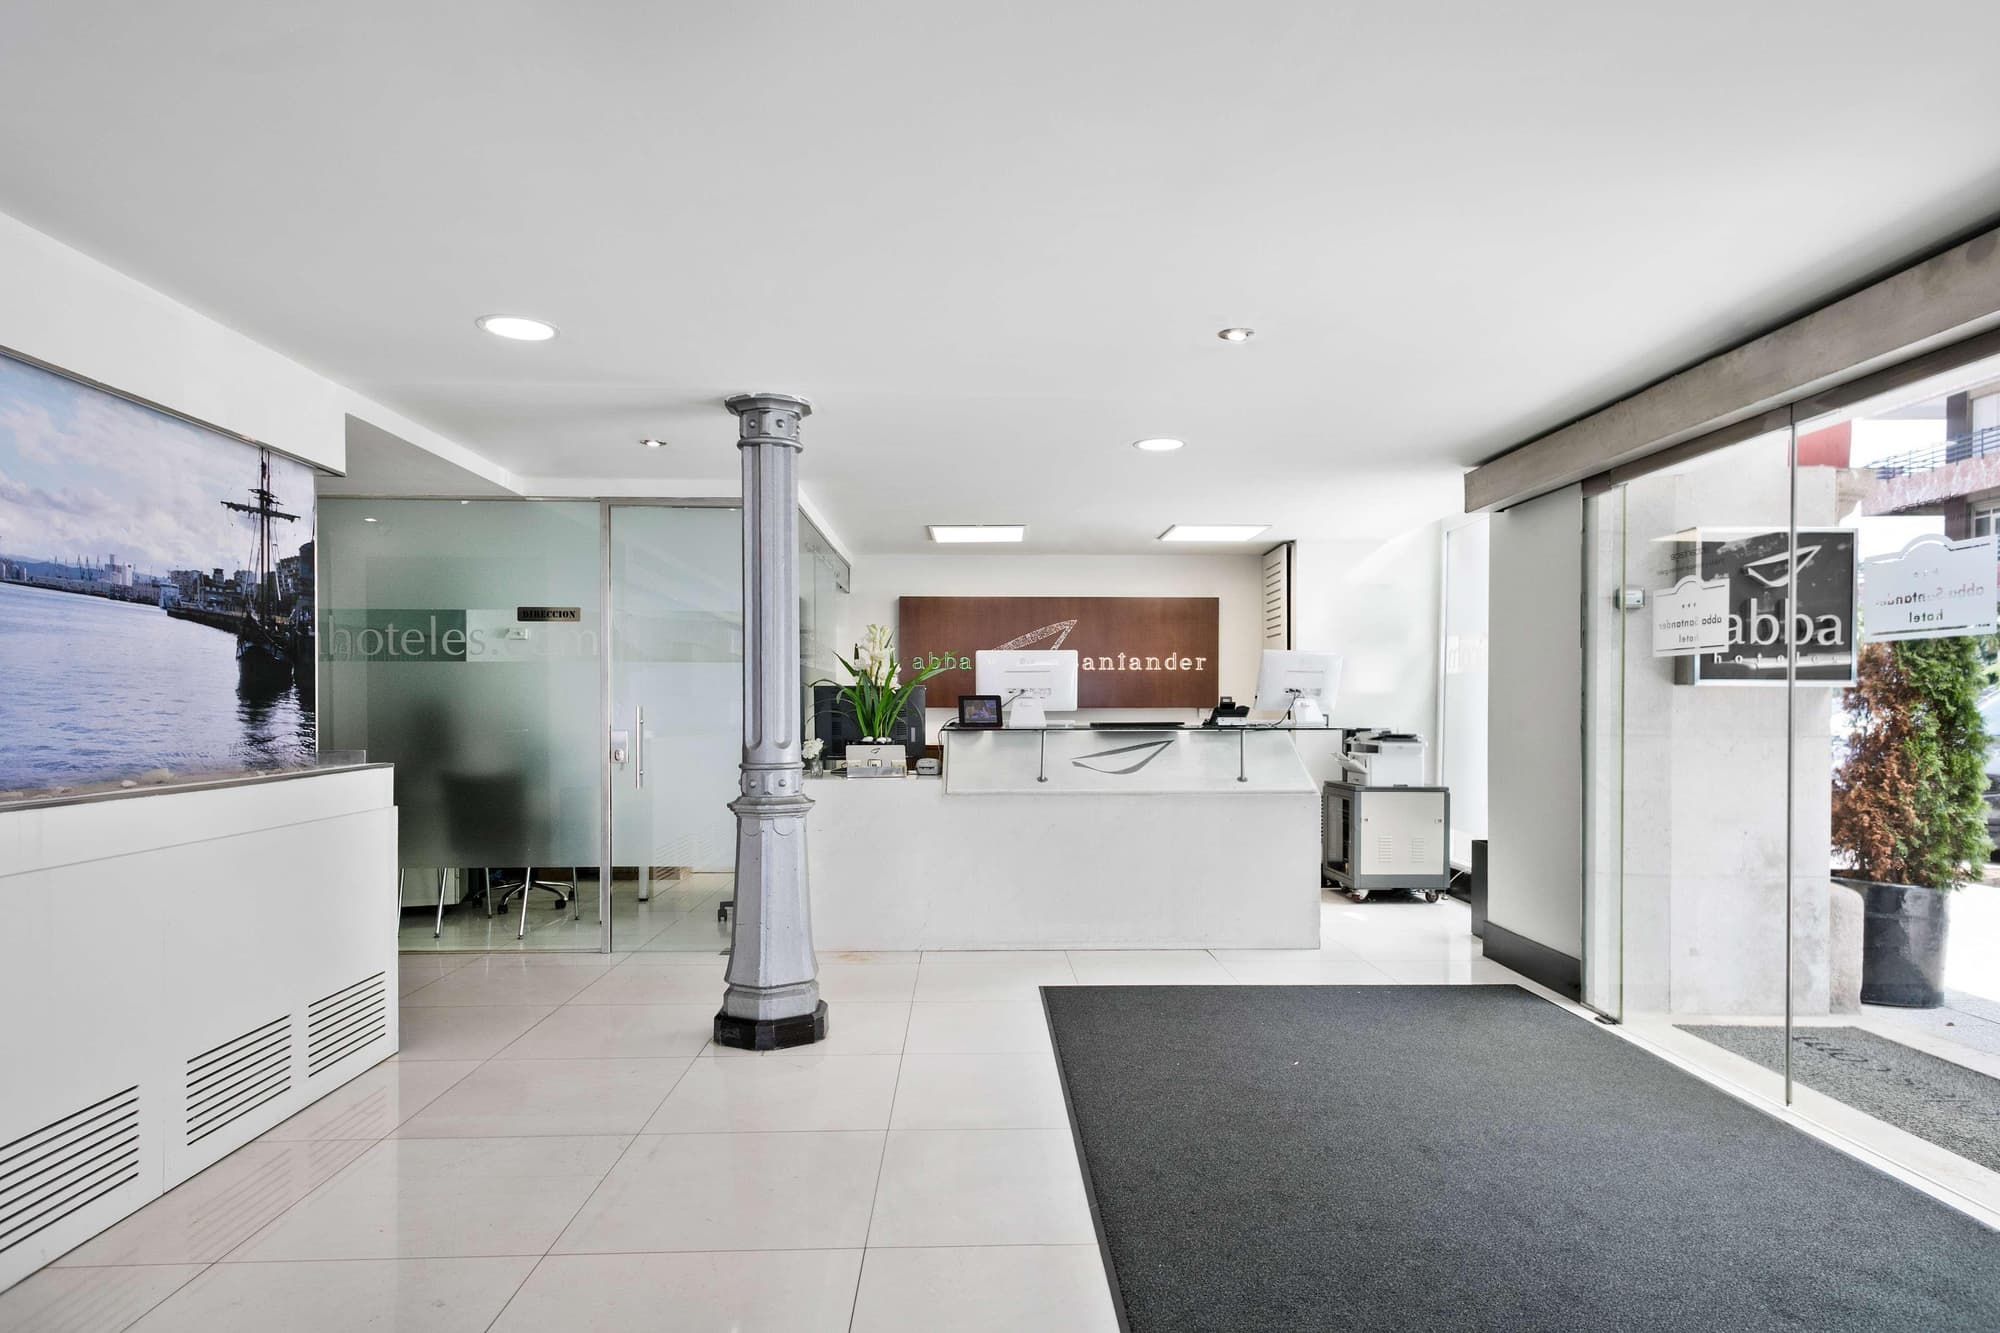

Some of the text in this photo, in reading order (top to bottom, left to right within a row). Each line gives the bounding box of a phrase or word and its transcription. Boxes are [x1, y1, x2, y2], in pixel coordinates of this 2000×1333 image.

[522, 609, 577, 619] DIRECCION
[1729, 597, 1845, 646] abba
[1077, 651, 1208, 671] antander
